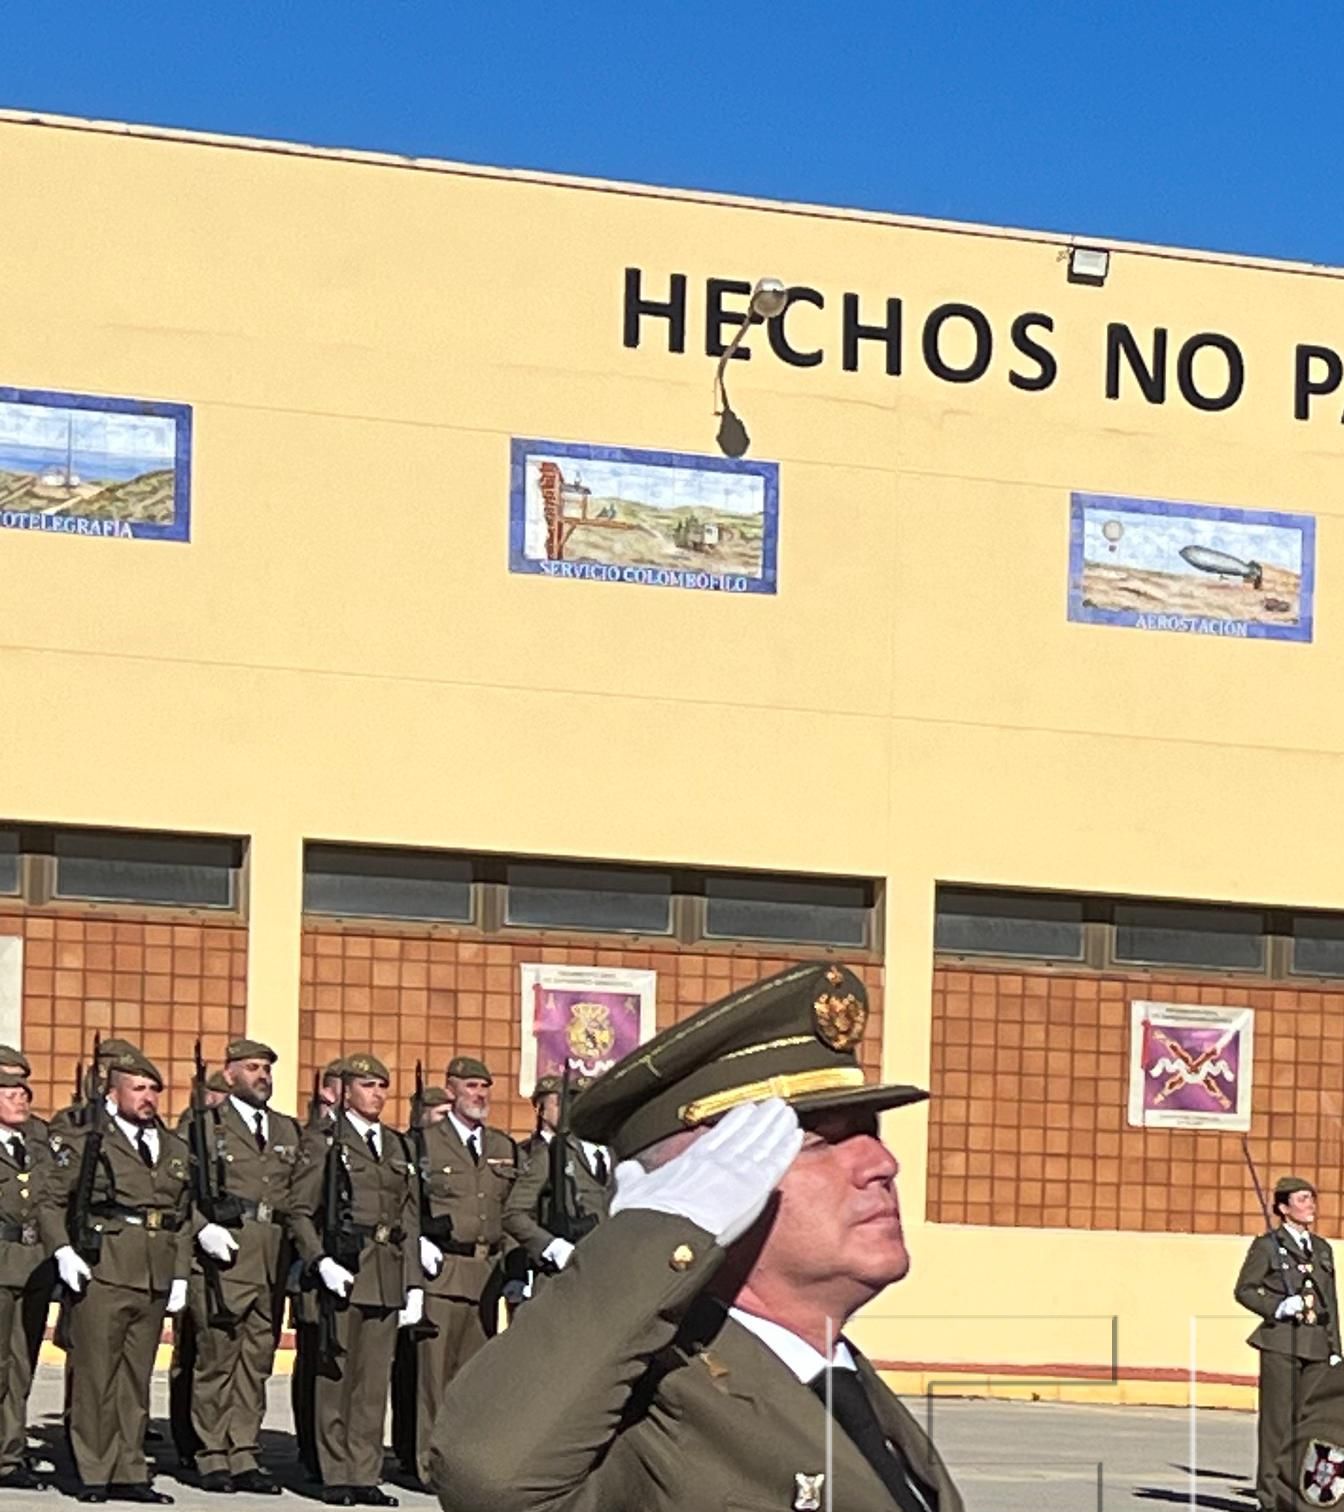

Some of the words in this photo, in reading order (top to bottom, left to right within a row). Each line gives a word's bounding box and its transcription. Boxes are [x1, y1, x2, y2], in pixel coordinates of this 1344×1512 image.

[623, 267, 1059, 392] HECHOS
[1104, 322, 1246, 412] NO
[540, 560, 620, 581] SERVICIO
